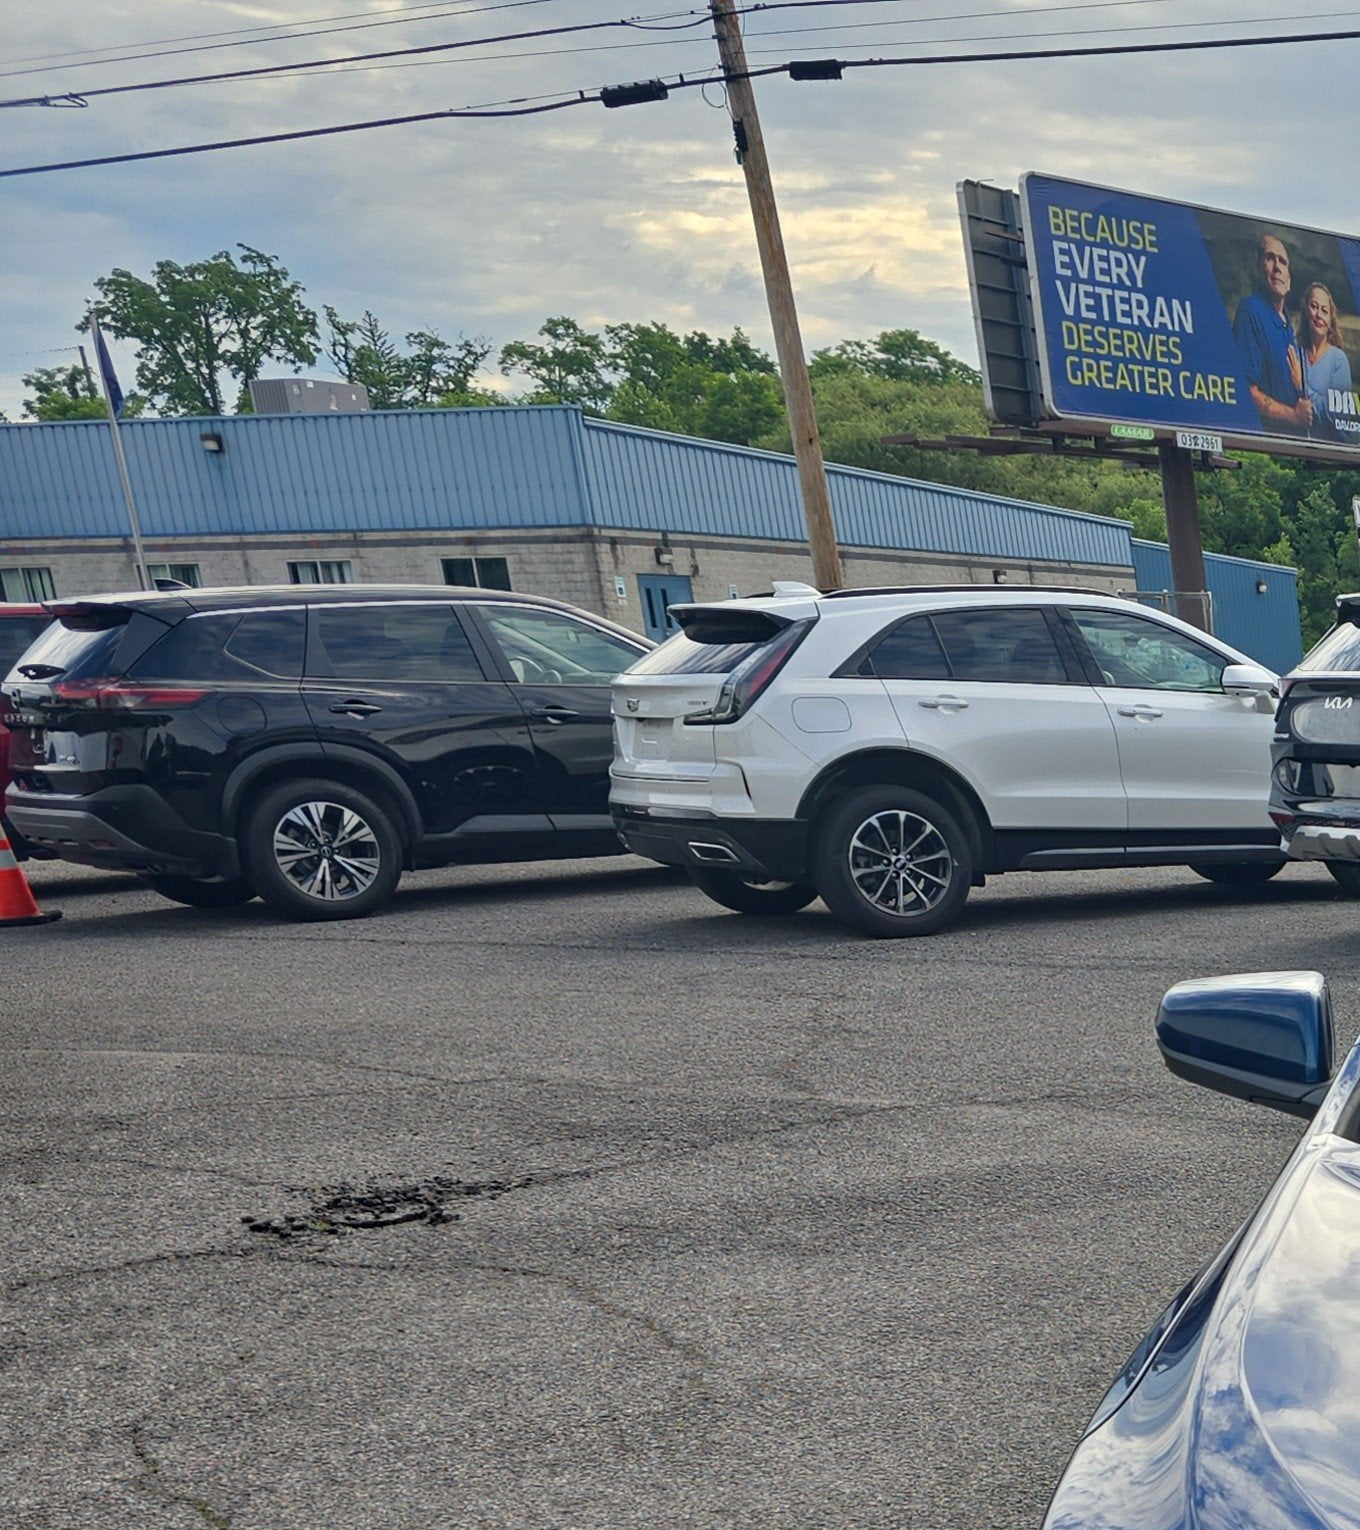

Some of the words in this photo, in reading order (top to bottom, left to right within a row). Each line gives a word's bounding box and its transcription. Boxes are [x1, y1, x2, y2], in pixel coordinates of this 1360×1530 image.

[1048, 205, 1158, 253] BECAUSE
[1052, 240, 1146, 288] EVERY
[1055, 279, 1194, 334] VETERAN
[1061, 320, 1183, 365] DESERVES
[1065, 355, 1175, 398] GREATER
[1178, 371, 1237, 405] CARE
[1324, 696, 1353, 709] KIA
